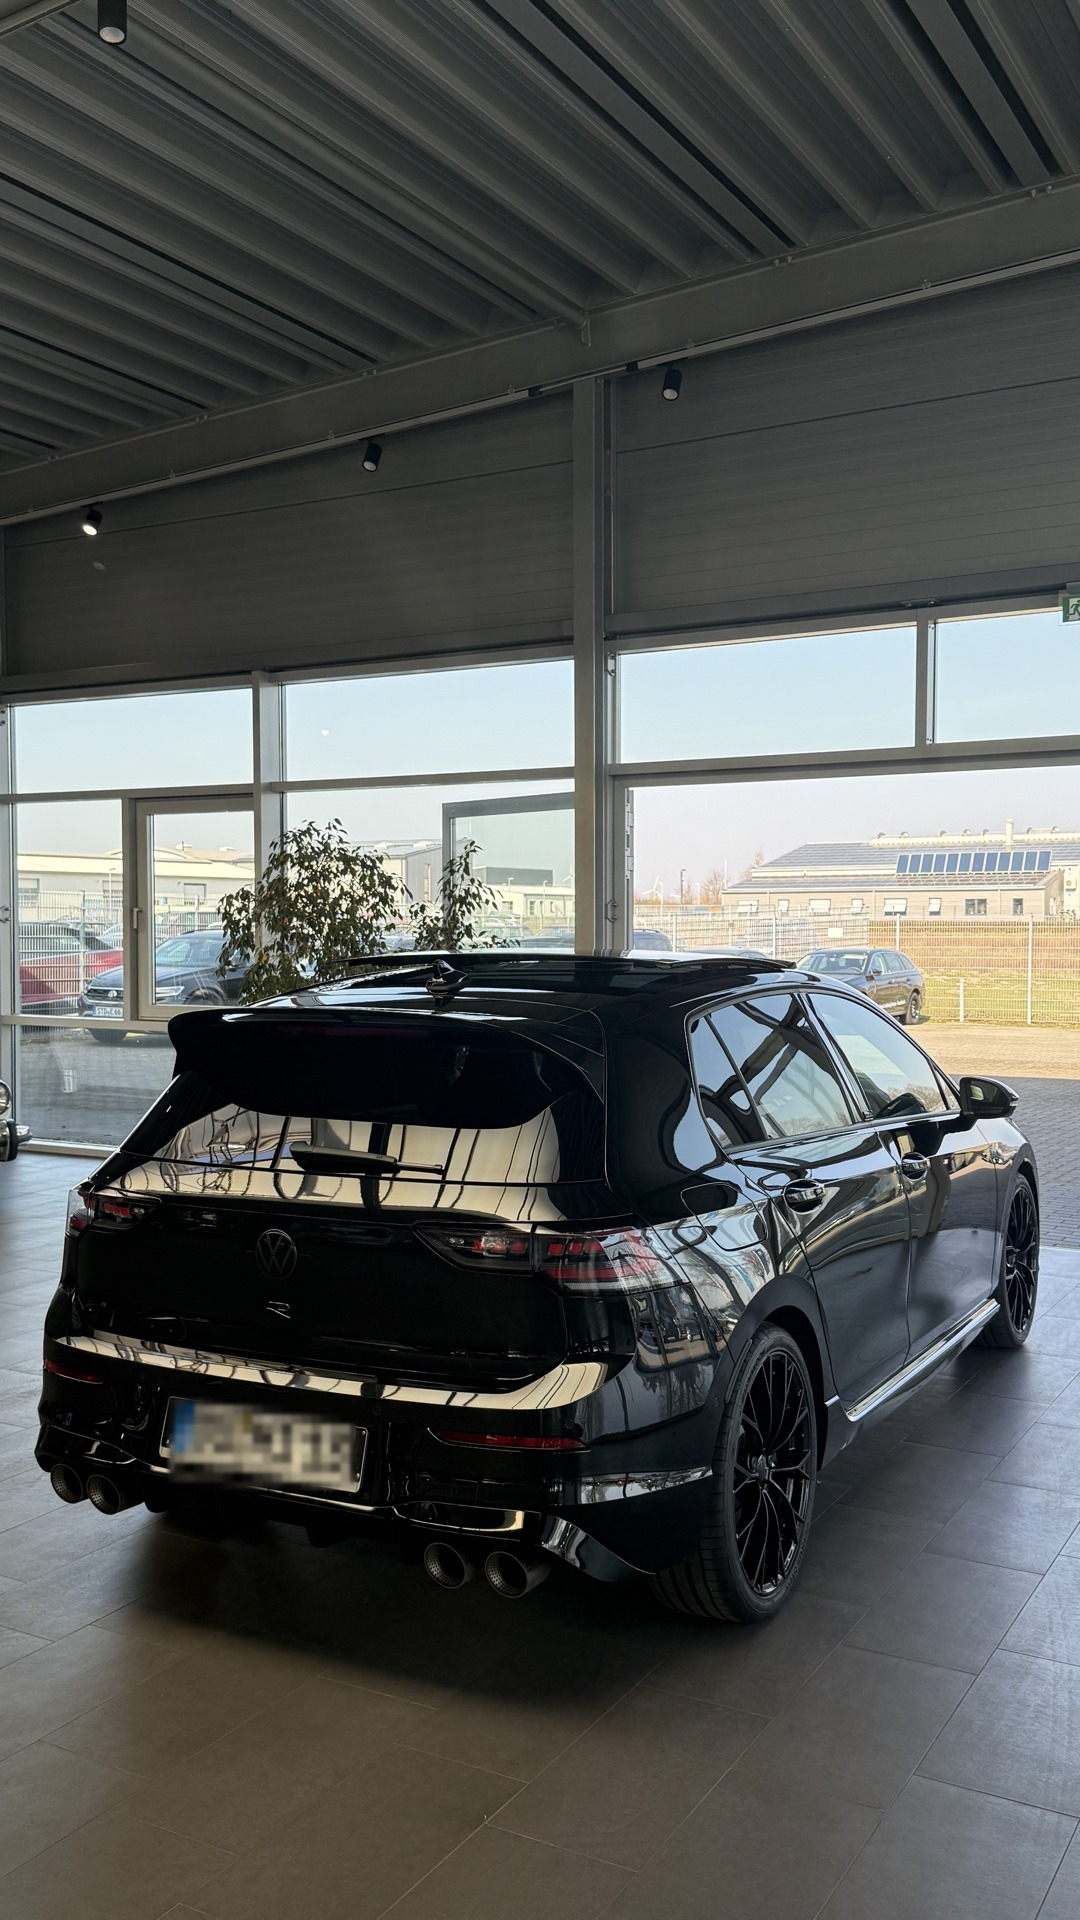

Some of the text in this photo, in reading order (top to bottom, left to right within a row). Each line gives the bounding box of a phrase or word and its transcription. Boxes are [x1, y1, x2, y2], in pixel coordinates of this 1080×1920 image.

[97, 1007, 107, 1015] STD
[256, 1229, 297, 1278] VW
[266, 1301, 291, 1319] R
